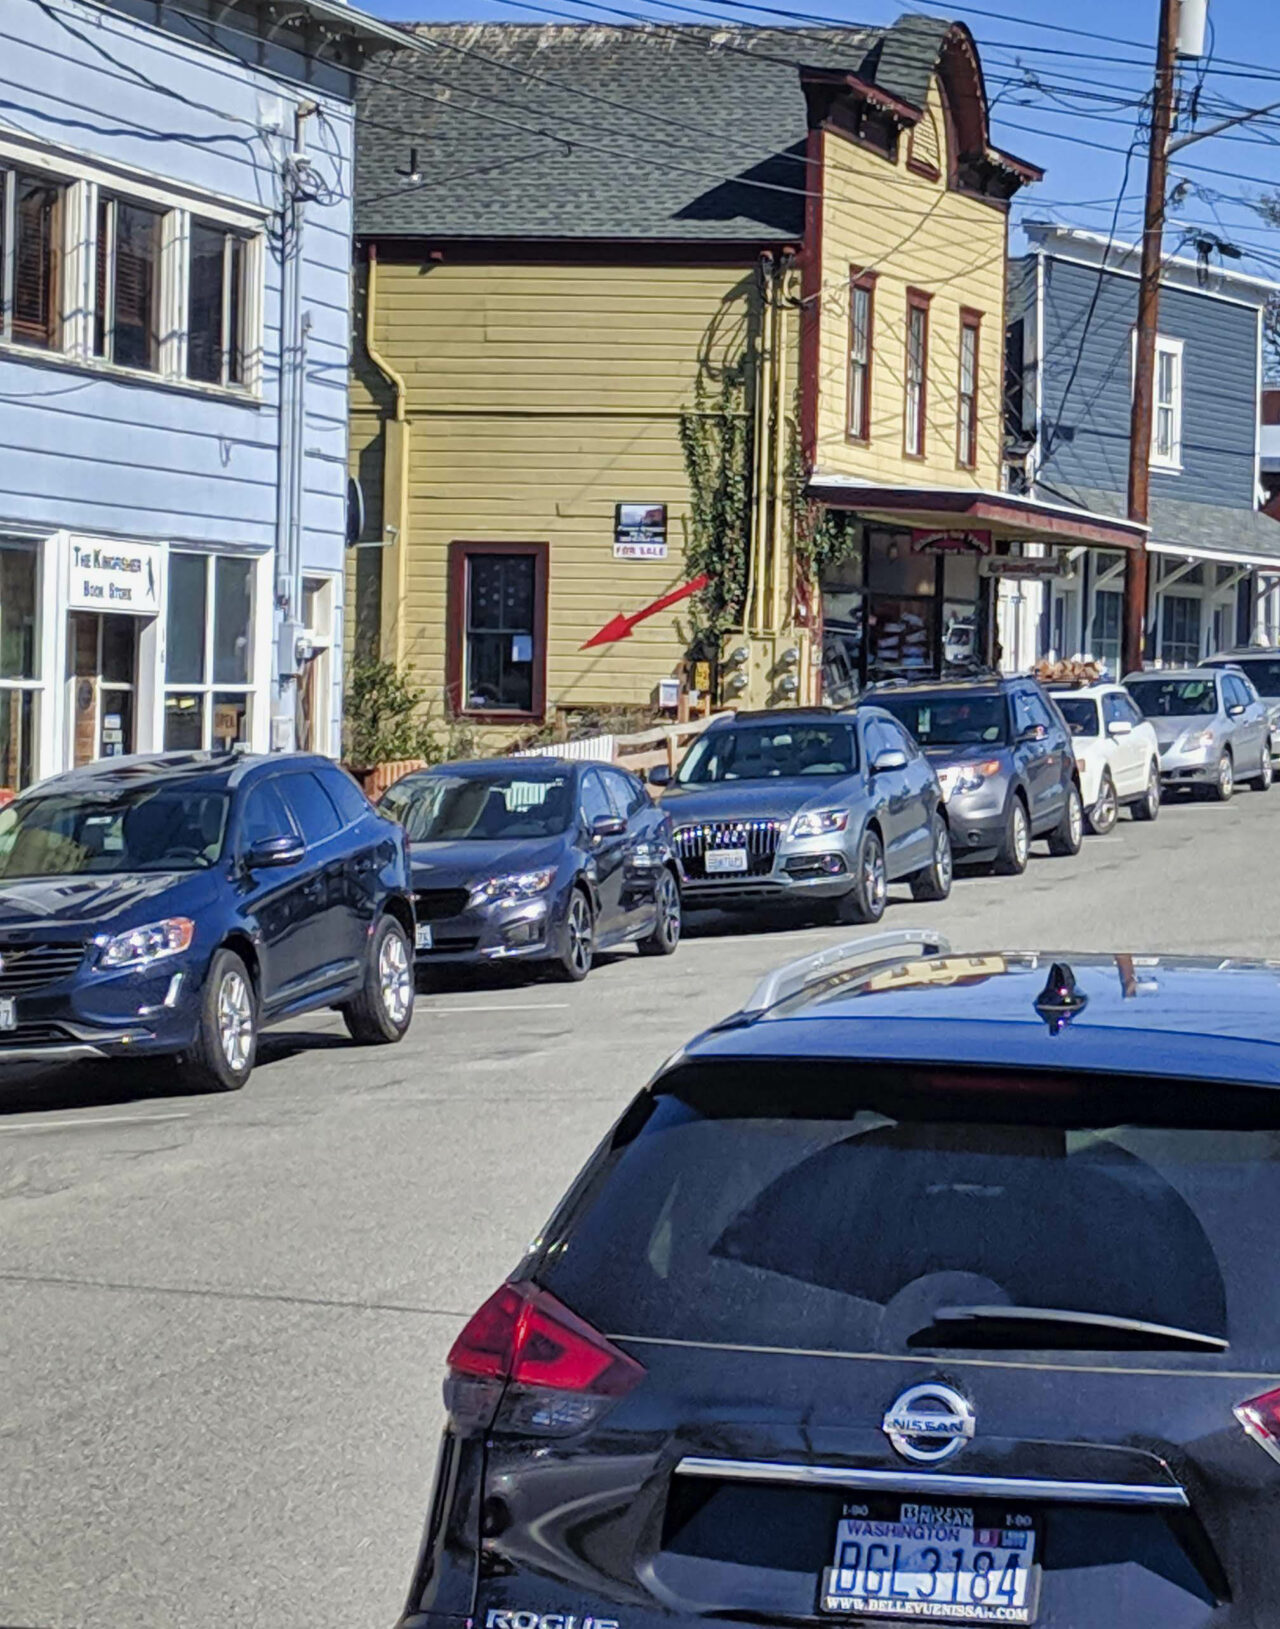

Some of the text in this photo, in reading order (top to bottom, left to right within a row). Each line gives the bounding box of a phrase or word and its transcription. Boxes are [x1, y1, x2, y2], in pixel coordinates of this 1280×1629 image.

[616, 546, 664, 556] FOR SALE
[892, 1418, 965, 1433] NISSAN
[847, 1521, 961, 1543] WASHINGTON
